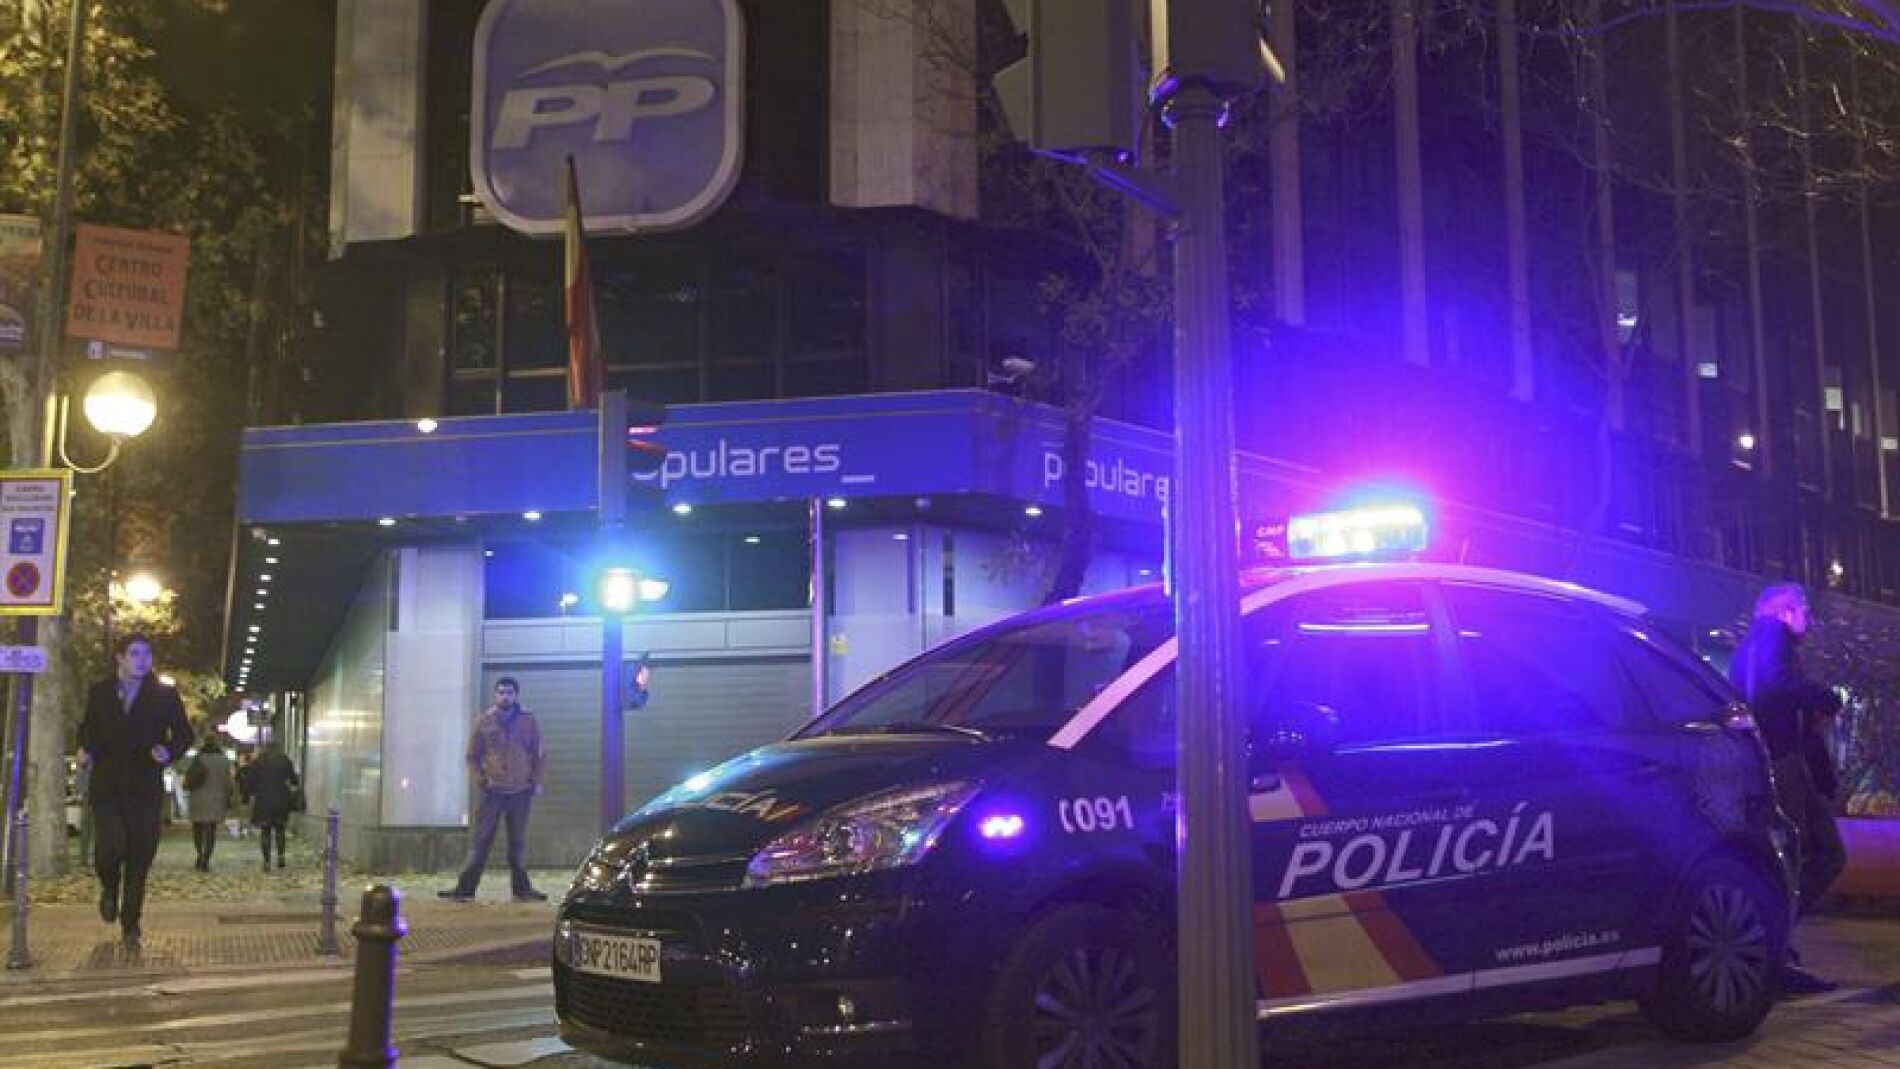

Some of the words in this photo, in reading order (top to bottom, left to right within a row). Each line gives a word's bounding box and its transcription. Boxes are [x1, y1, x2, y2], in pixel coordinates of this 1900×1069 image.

[492, 75, 715, 149] PP
[94, 254, 164, 279] CENTRO
[1300, 816, 1369, 838] CUERPO
[1371, 808, 1449, 830] NACIONAL
[1453, 801, 1476, 819] DE
[1277, 800, 1555, 898] POLICÍA
